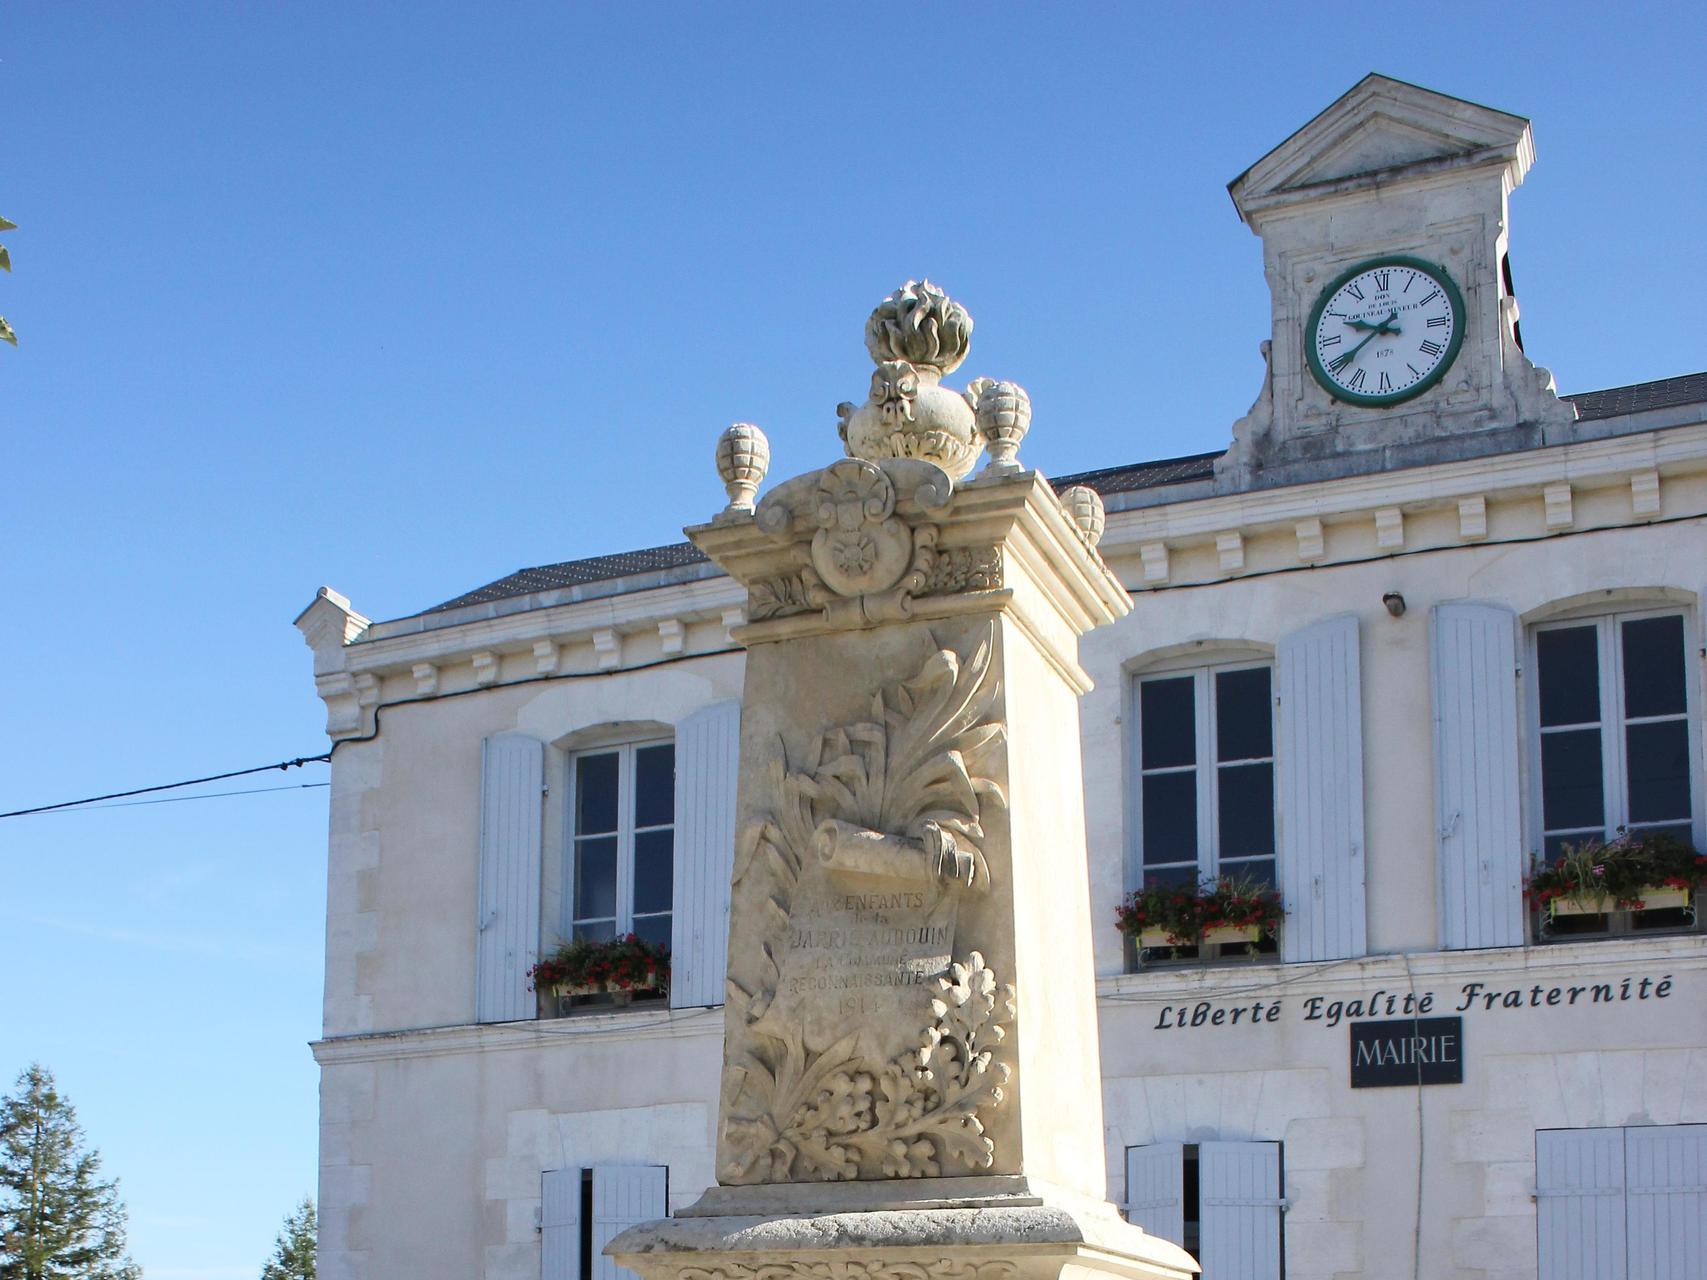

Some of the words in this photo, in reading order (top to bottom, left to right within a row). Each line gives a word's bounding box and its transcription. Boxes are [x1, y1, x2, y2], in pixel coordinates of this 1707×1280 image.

[845, 892, 924, 910] ENFANTS
[1304, 990, 1435, 1026] Egalité
[1456, 975, 1673, 1012] Fraternité
[1355, 1035, 1456, 1067] MAIRIE
